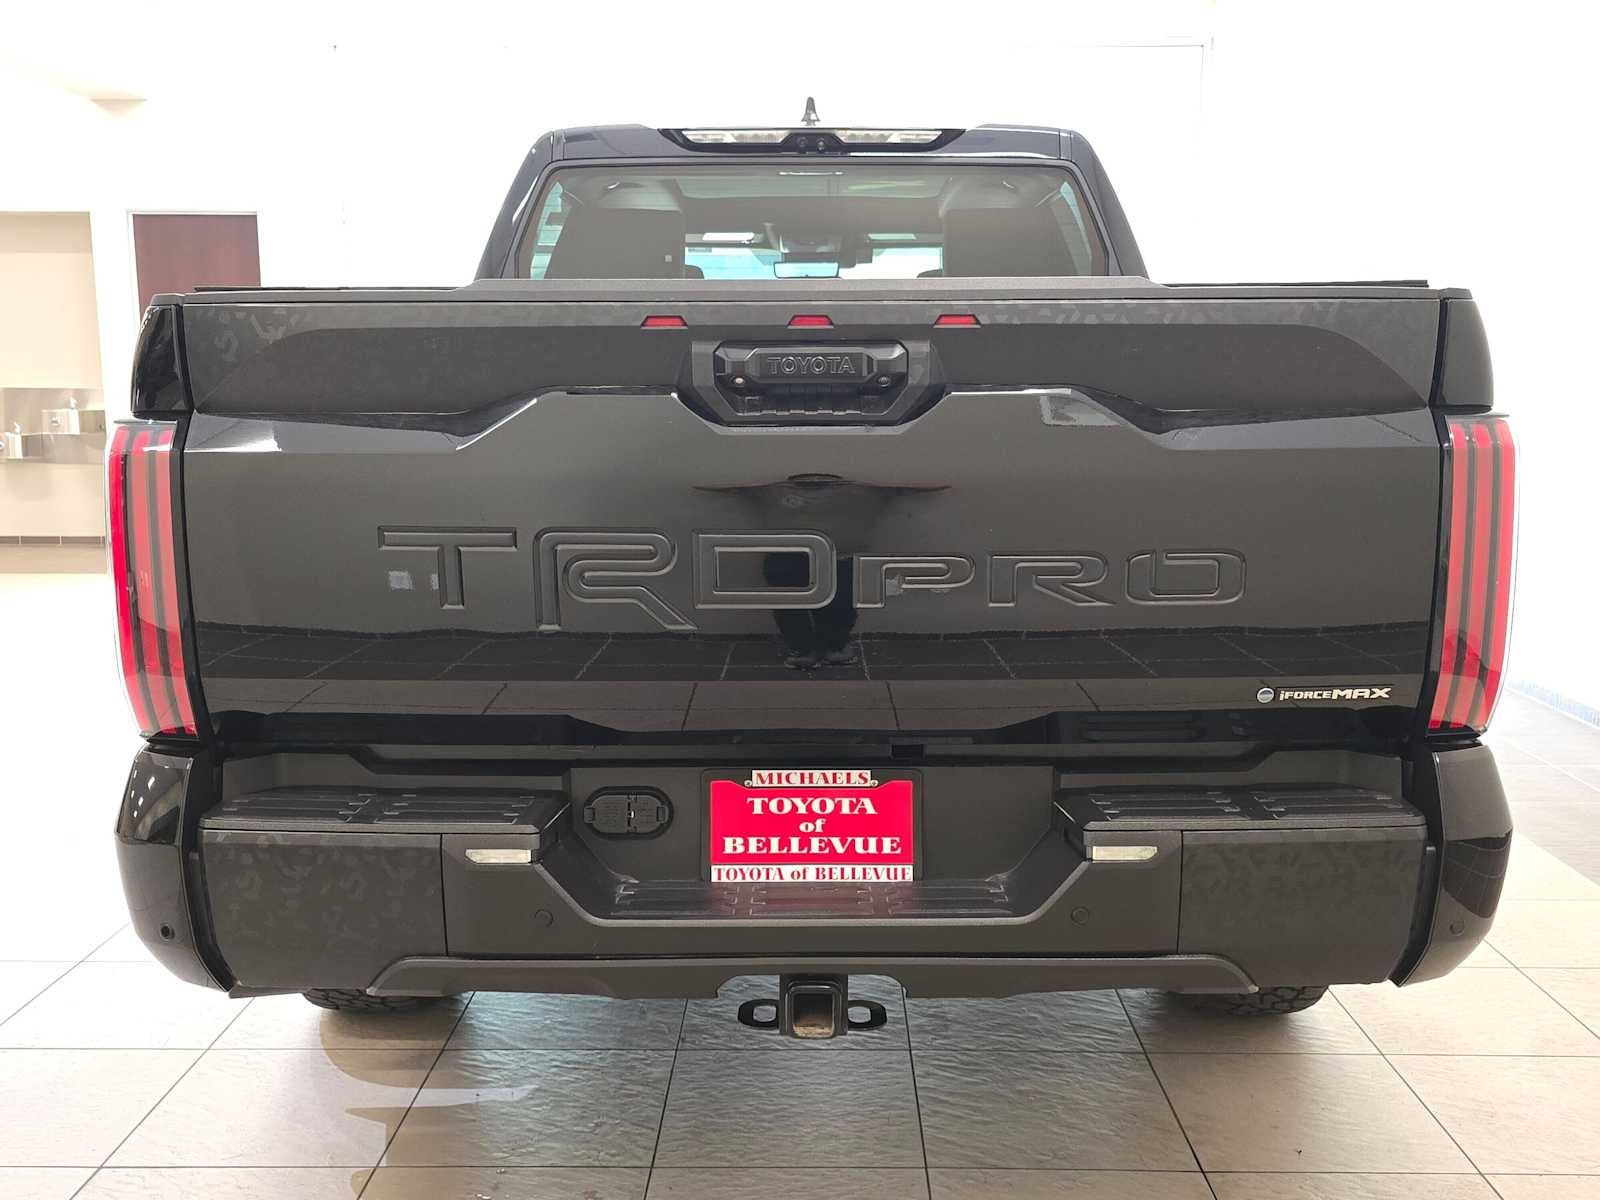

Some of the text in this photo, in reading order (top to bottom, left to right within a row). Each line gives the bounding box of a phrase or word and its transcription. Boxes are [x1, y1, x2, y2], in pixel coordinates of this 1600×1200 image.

[767, 356, 856, 375] TOYOTA
[377, 525, 1249, 633] TRD PRO
[756, 771, 869, 785] MICHAELS
[747, 797, 878, 815] TOYOTA
[799, 818, 826, 833] of
[723, 836, 902, 854] BELLEVUE
[713, 867, 911, 881] TOYOTA of BELLEVUE
